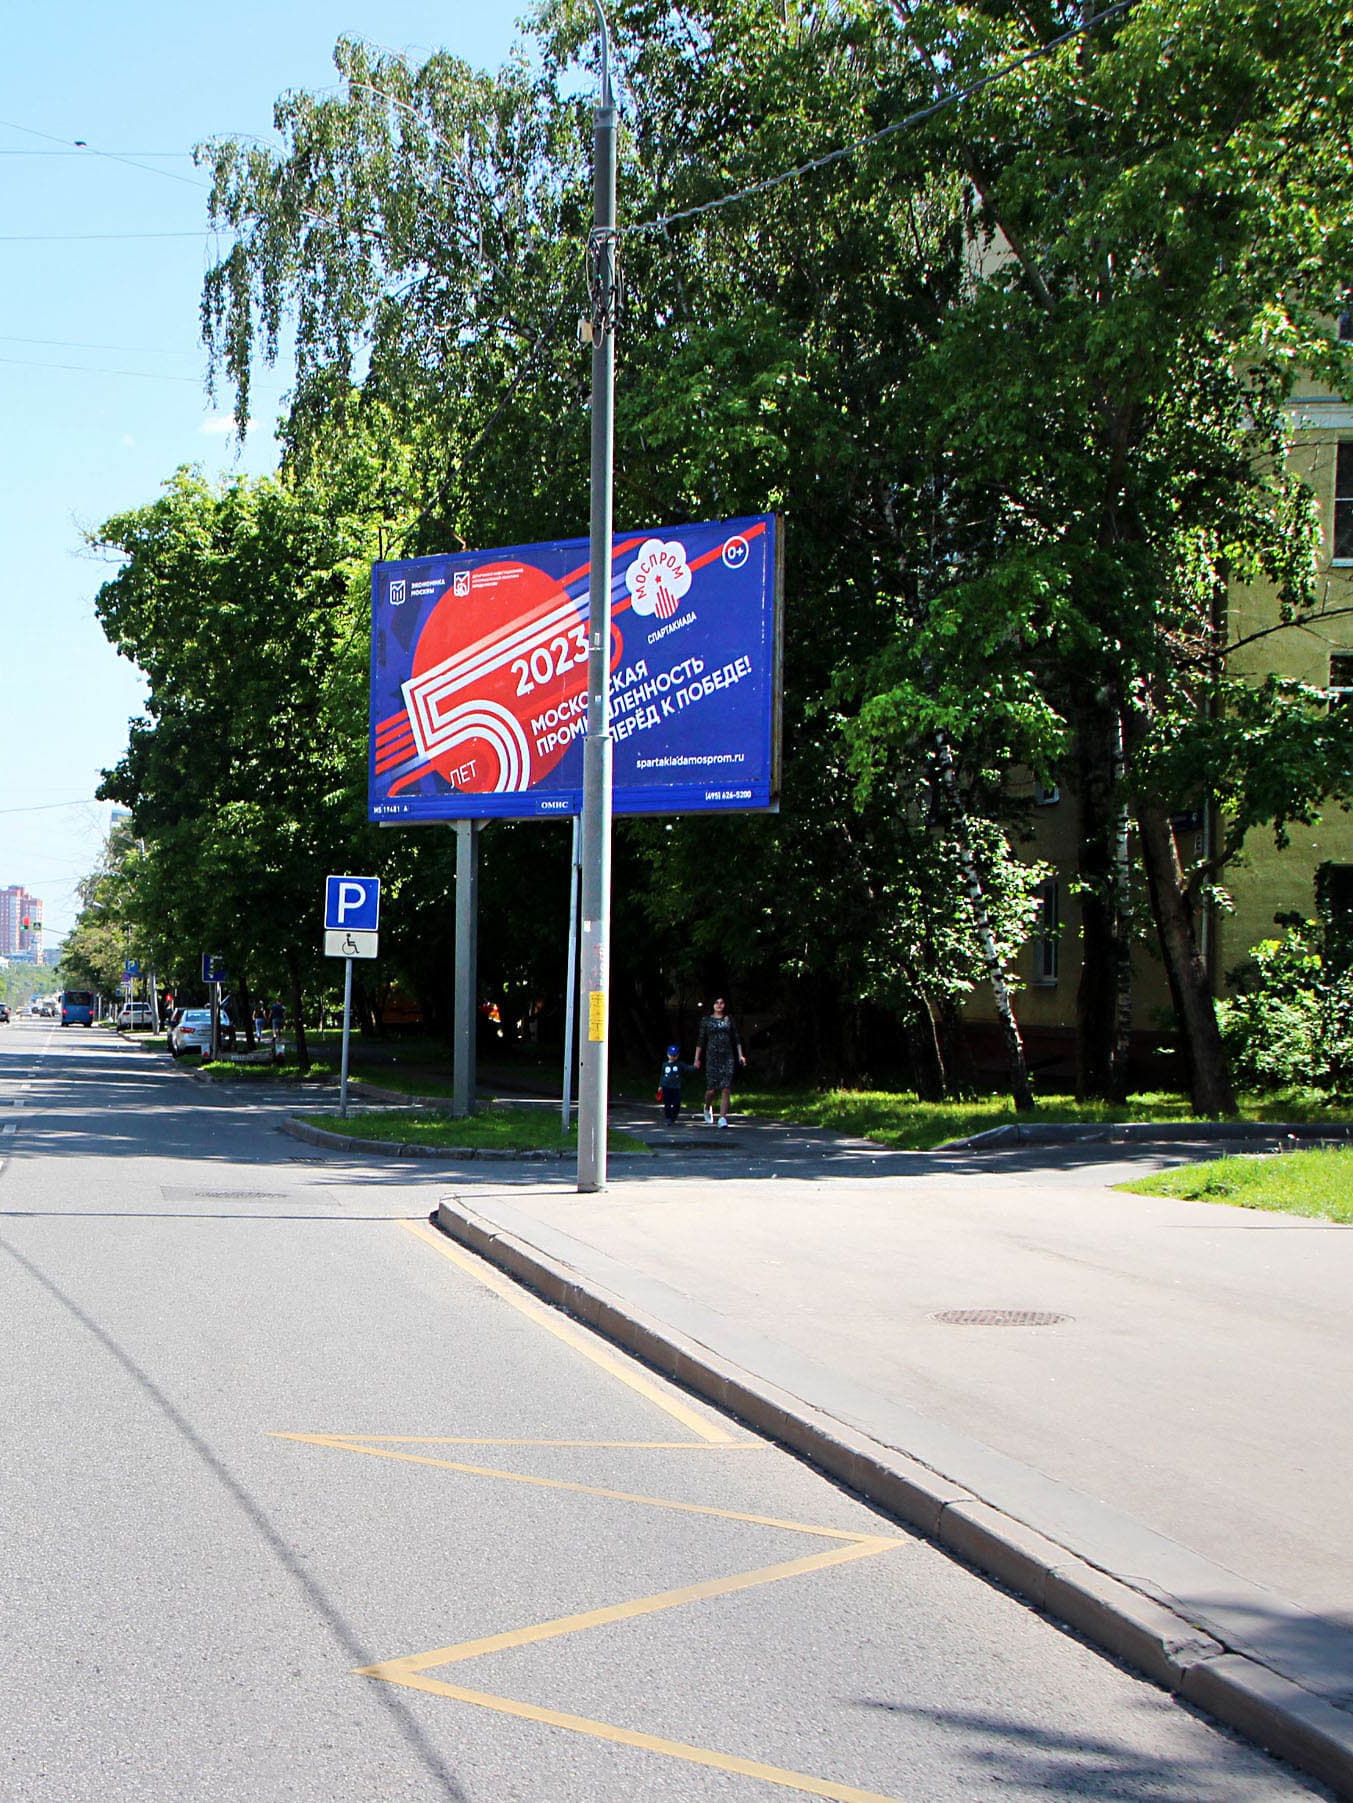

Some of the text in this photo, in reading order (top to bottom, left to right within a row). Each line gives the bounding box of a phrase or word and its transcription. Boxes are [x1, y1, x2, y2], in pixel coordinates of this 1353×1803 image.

[635, 551, 685, 600] МОСПРОМ
[728, 546, 744, 560] 0+
[647, 611, 697, 644] СПАРТАКИАДА
[511, 624, 590, 698] 2023
[530, 659, 649, 736] МОСКОКАЯ
[536, 656, 705, 757] ПРОМЛЕННОСТЬ
[661, 699, 676, 718] К
[676, 655, 752, 709] ПОБЕДЕ!
[449, 759, 477, 789] ЛЕТ
[636, 753, 745, 769] spartakiadamosprom.ru
[337, 882, 366, 924] P
